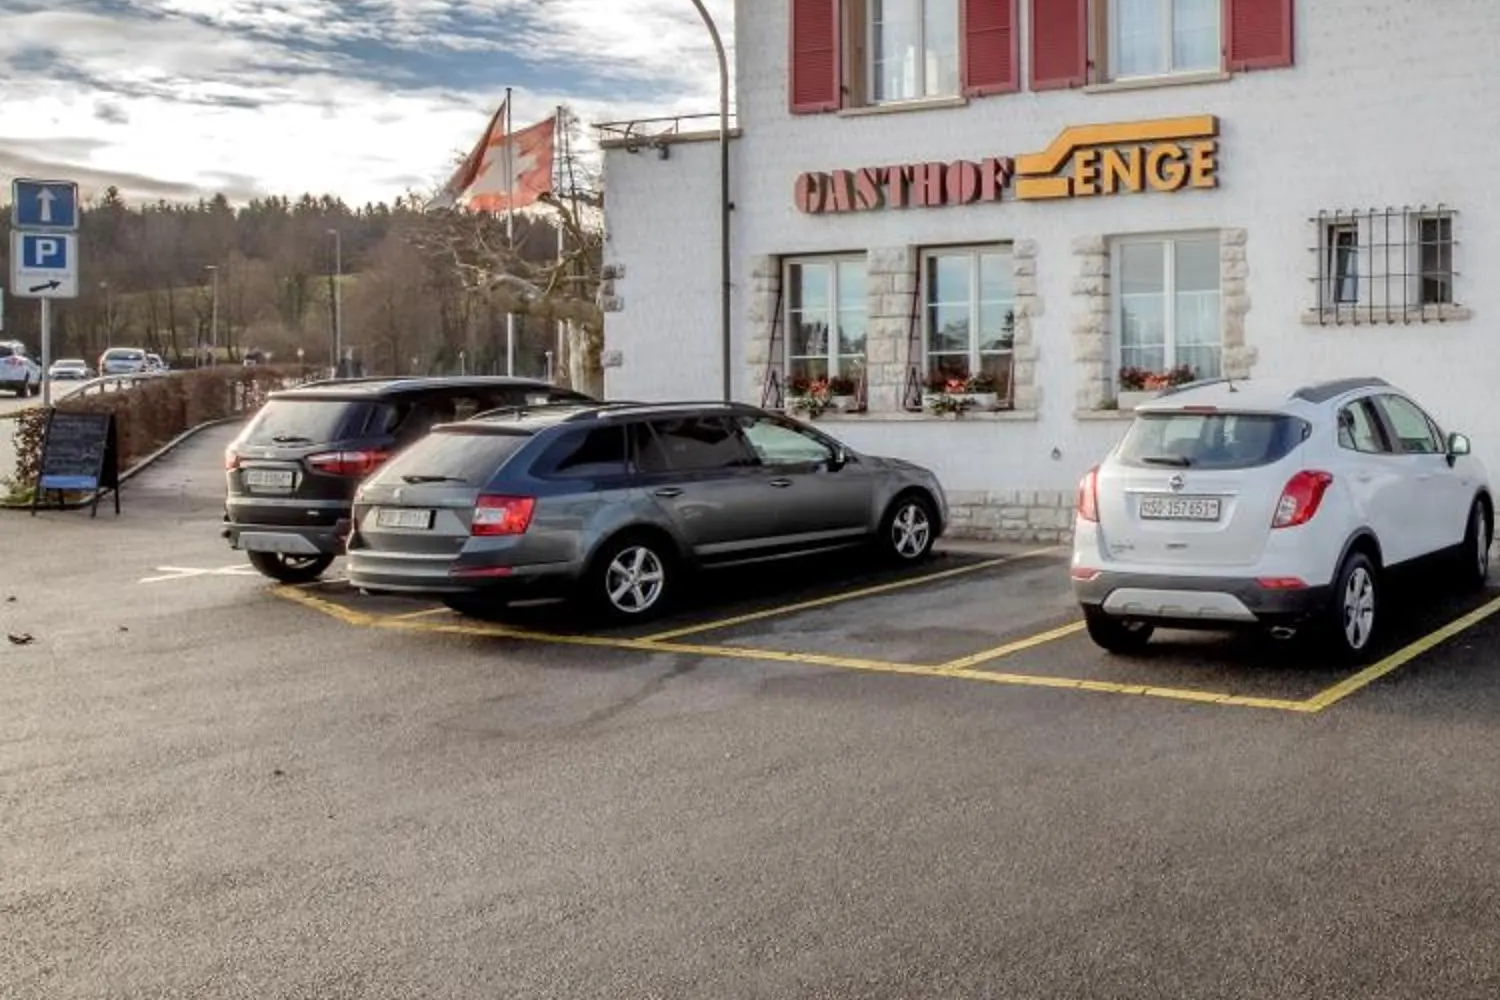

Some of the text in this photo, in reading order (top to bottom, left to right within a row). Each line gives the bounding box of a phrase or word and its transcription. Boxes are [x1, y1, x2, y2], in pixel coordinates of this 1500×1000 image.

[794, 140, 1218, 215] GASTHOF ENGE
[36, 239, 58, 265] P
